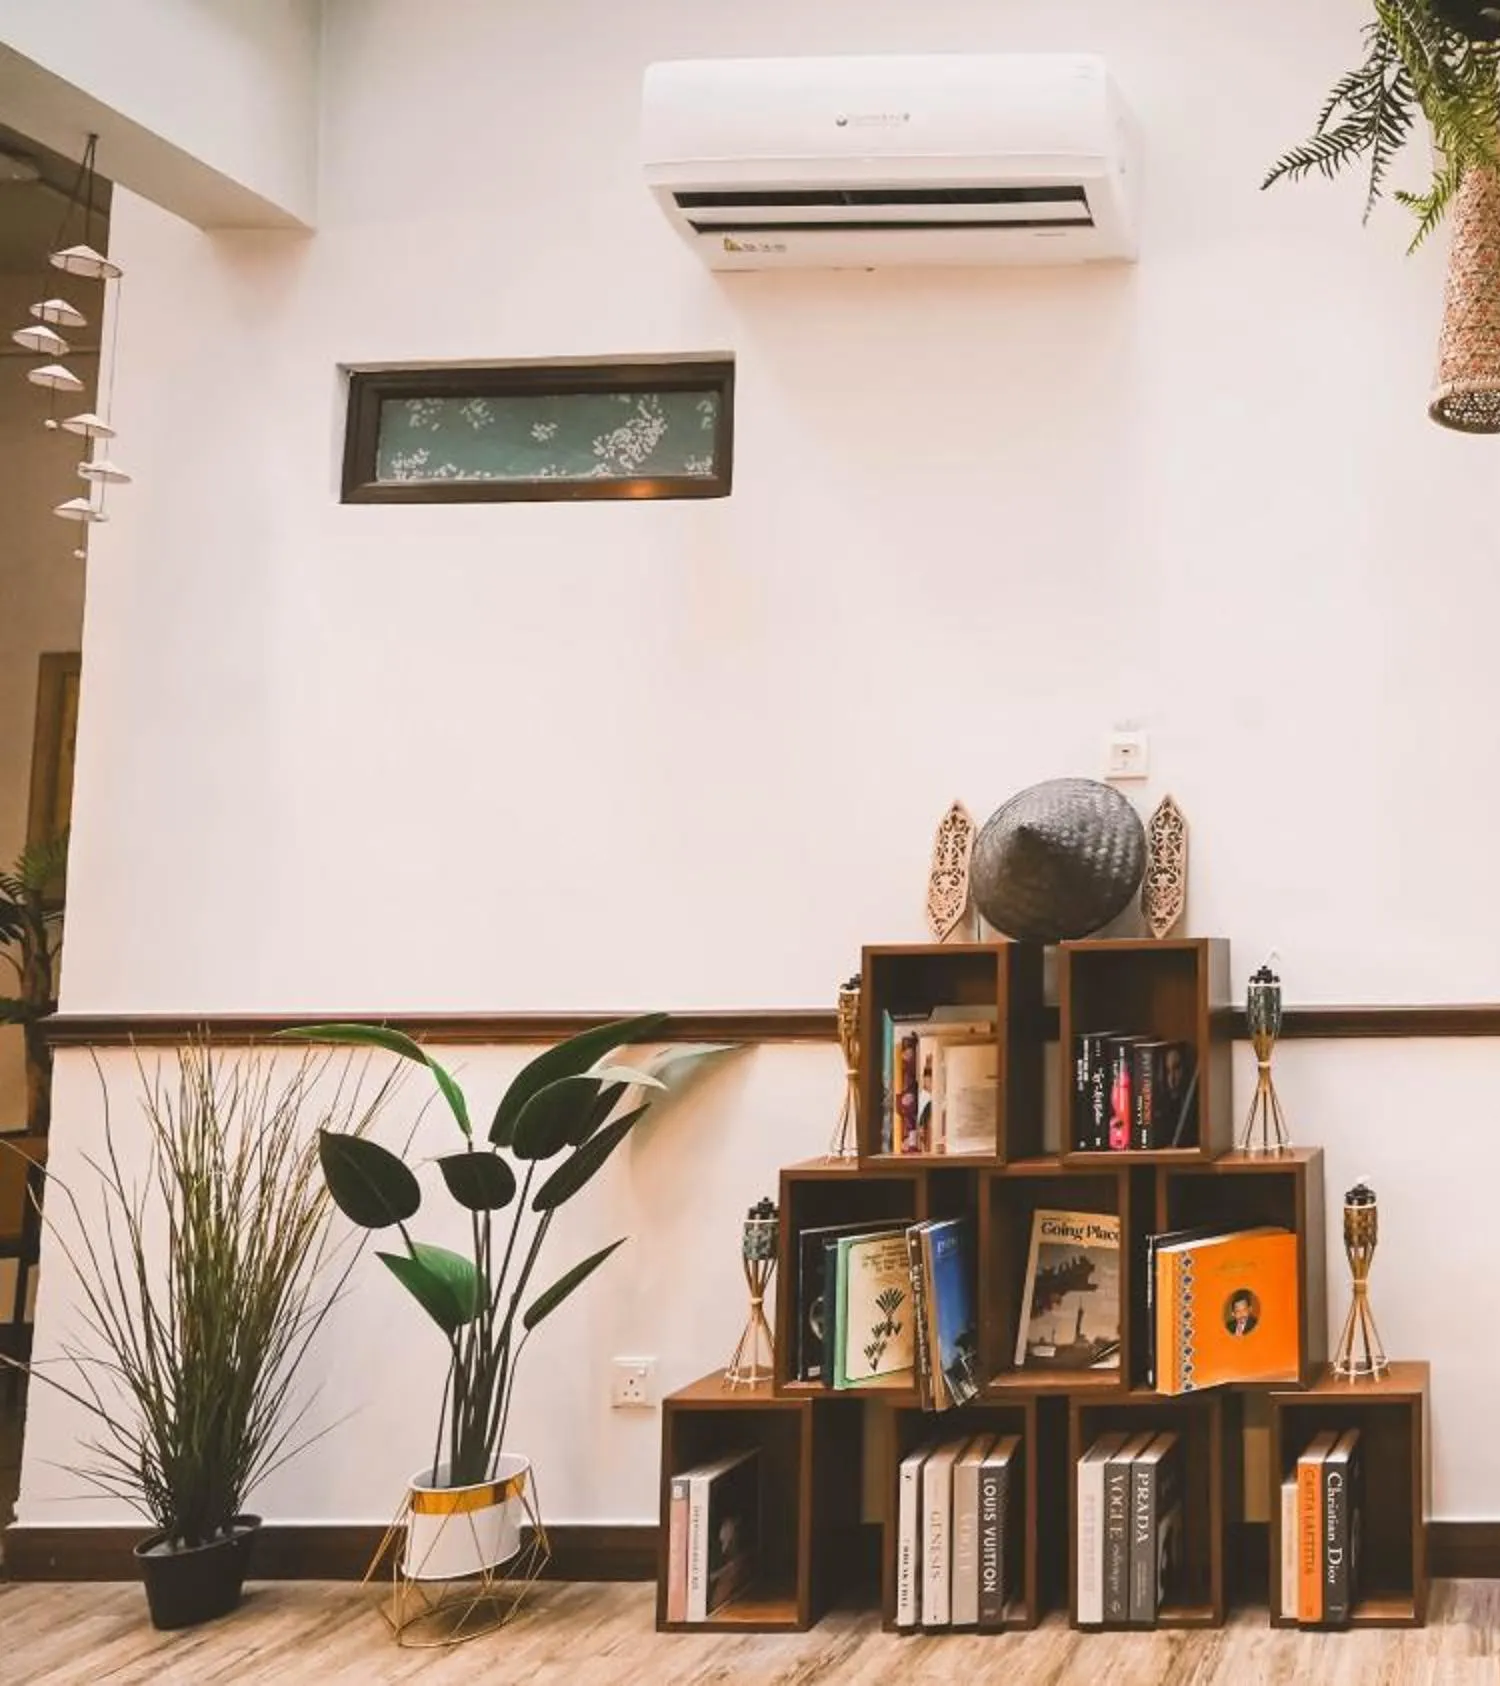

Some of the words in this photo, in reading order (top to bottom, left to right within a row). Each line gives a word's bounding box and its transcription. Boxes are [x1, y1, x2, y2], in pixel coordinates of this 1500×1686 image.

[1041, 1221, 1083, 1241] Going
[983, 1478, 997, 1521] LOUIS
[1109, 1475, 1124, 1540] VOGUE
[1136, 1472, 1149, 1545] PRADA
[1327, 1471, 1343, 1541] Christian
[931, 1511, 943, 1580] GENESIS
[983, 1527, 997, 1593] VUITTON
[1327, 1546, 1343, 1584] Dior
